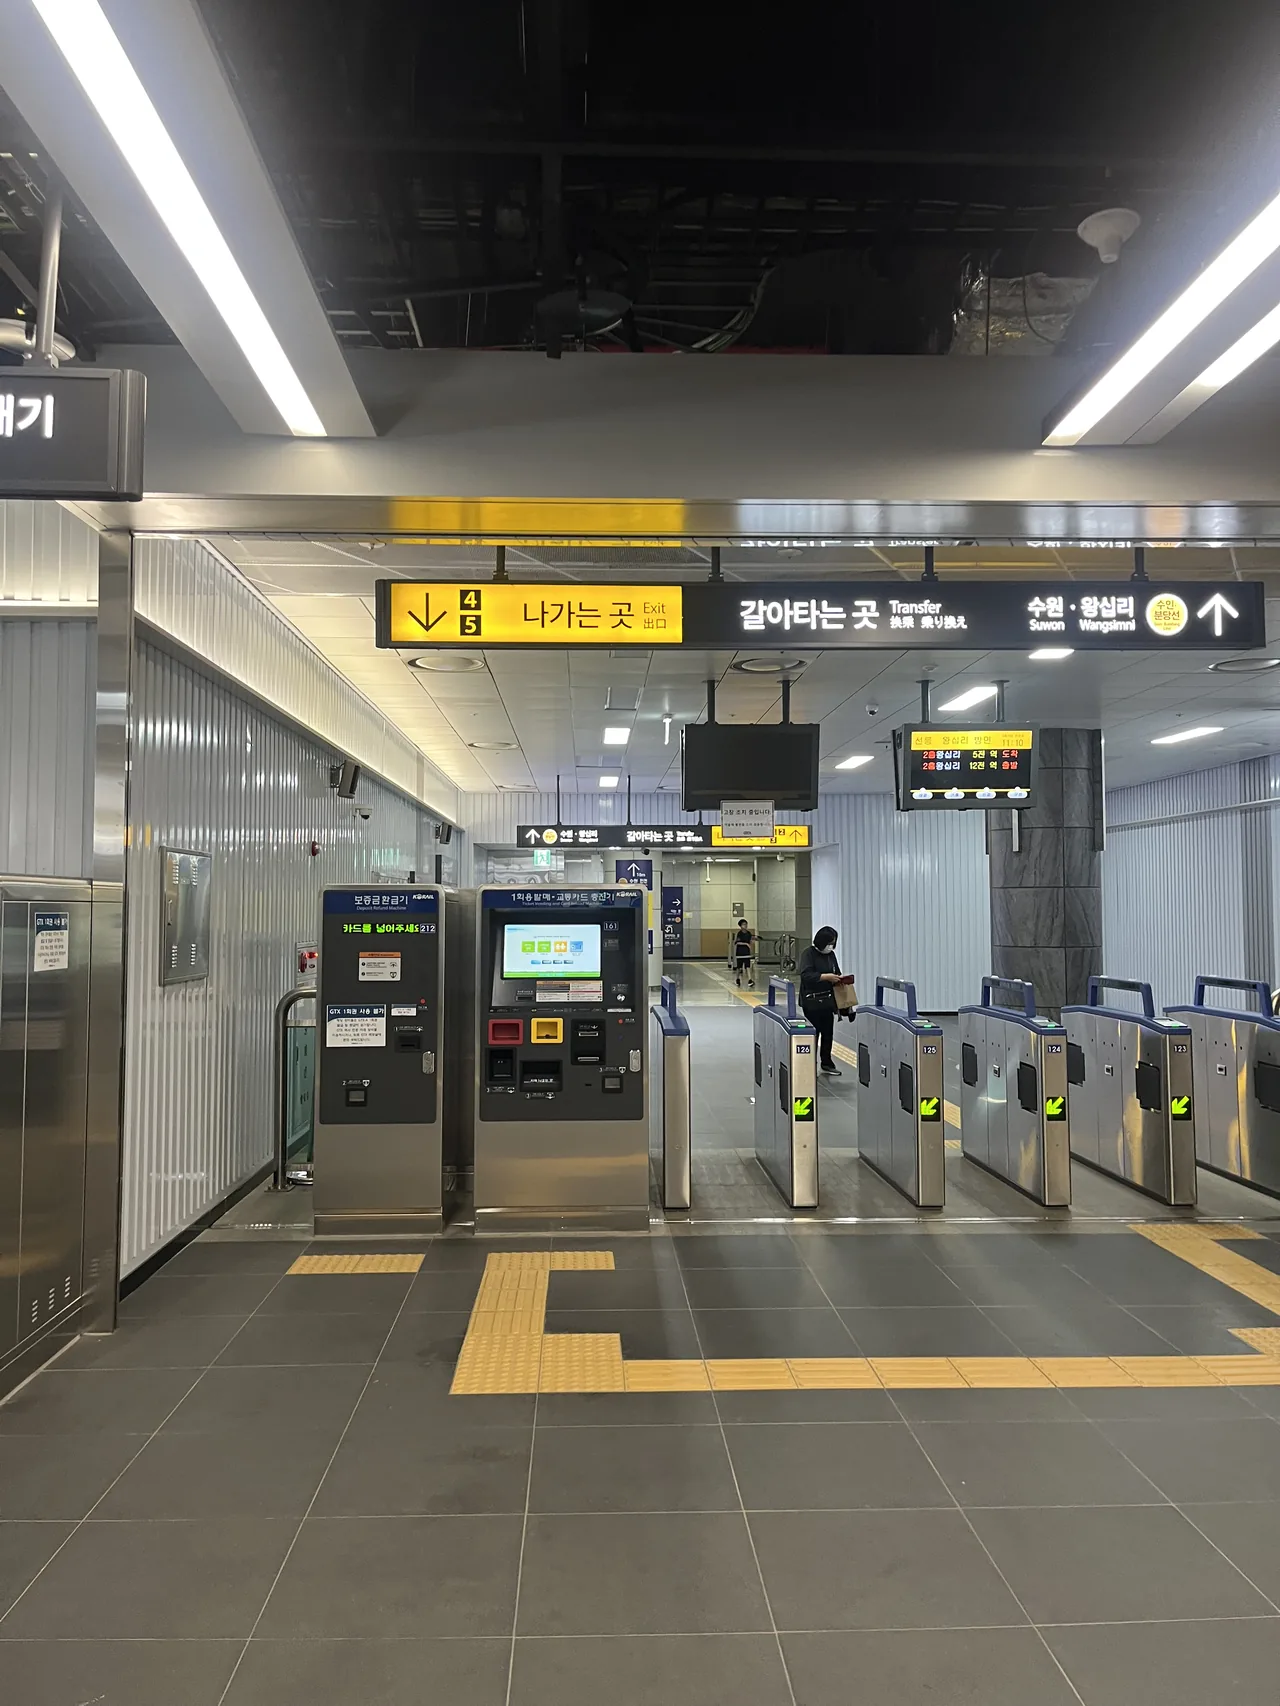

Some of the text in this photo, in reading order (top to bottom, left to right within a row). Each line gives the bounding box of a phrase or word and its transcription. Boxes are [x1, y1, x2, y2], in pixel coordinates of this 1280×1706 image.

[464, 591, 477, 608] 4
[889, 599, 942, 614] Transfer
[643, 602, 666, 614] Exit
[1027, 596, 1064, 618] 수원
[1080, 596, 1135, 618] 왕십리
[523, 600, 634, 629] 나가는 곳
[740, 599, 880, 630] 갈아타는 곳
[1154, 610, 1180, 620] 분당선
[464, 616, 477, 634] 5
[643, 617, 667, 629] 出口
[1029, 619, 1066, 631] Suwon
[1079, 619, 1136, 633] Wangsimni
[354, 895, 408, 906] 보증금 환급기
[343, 923, 372, 933] 카드를
